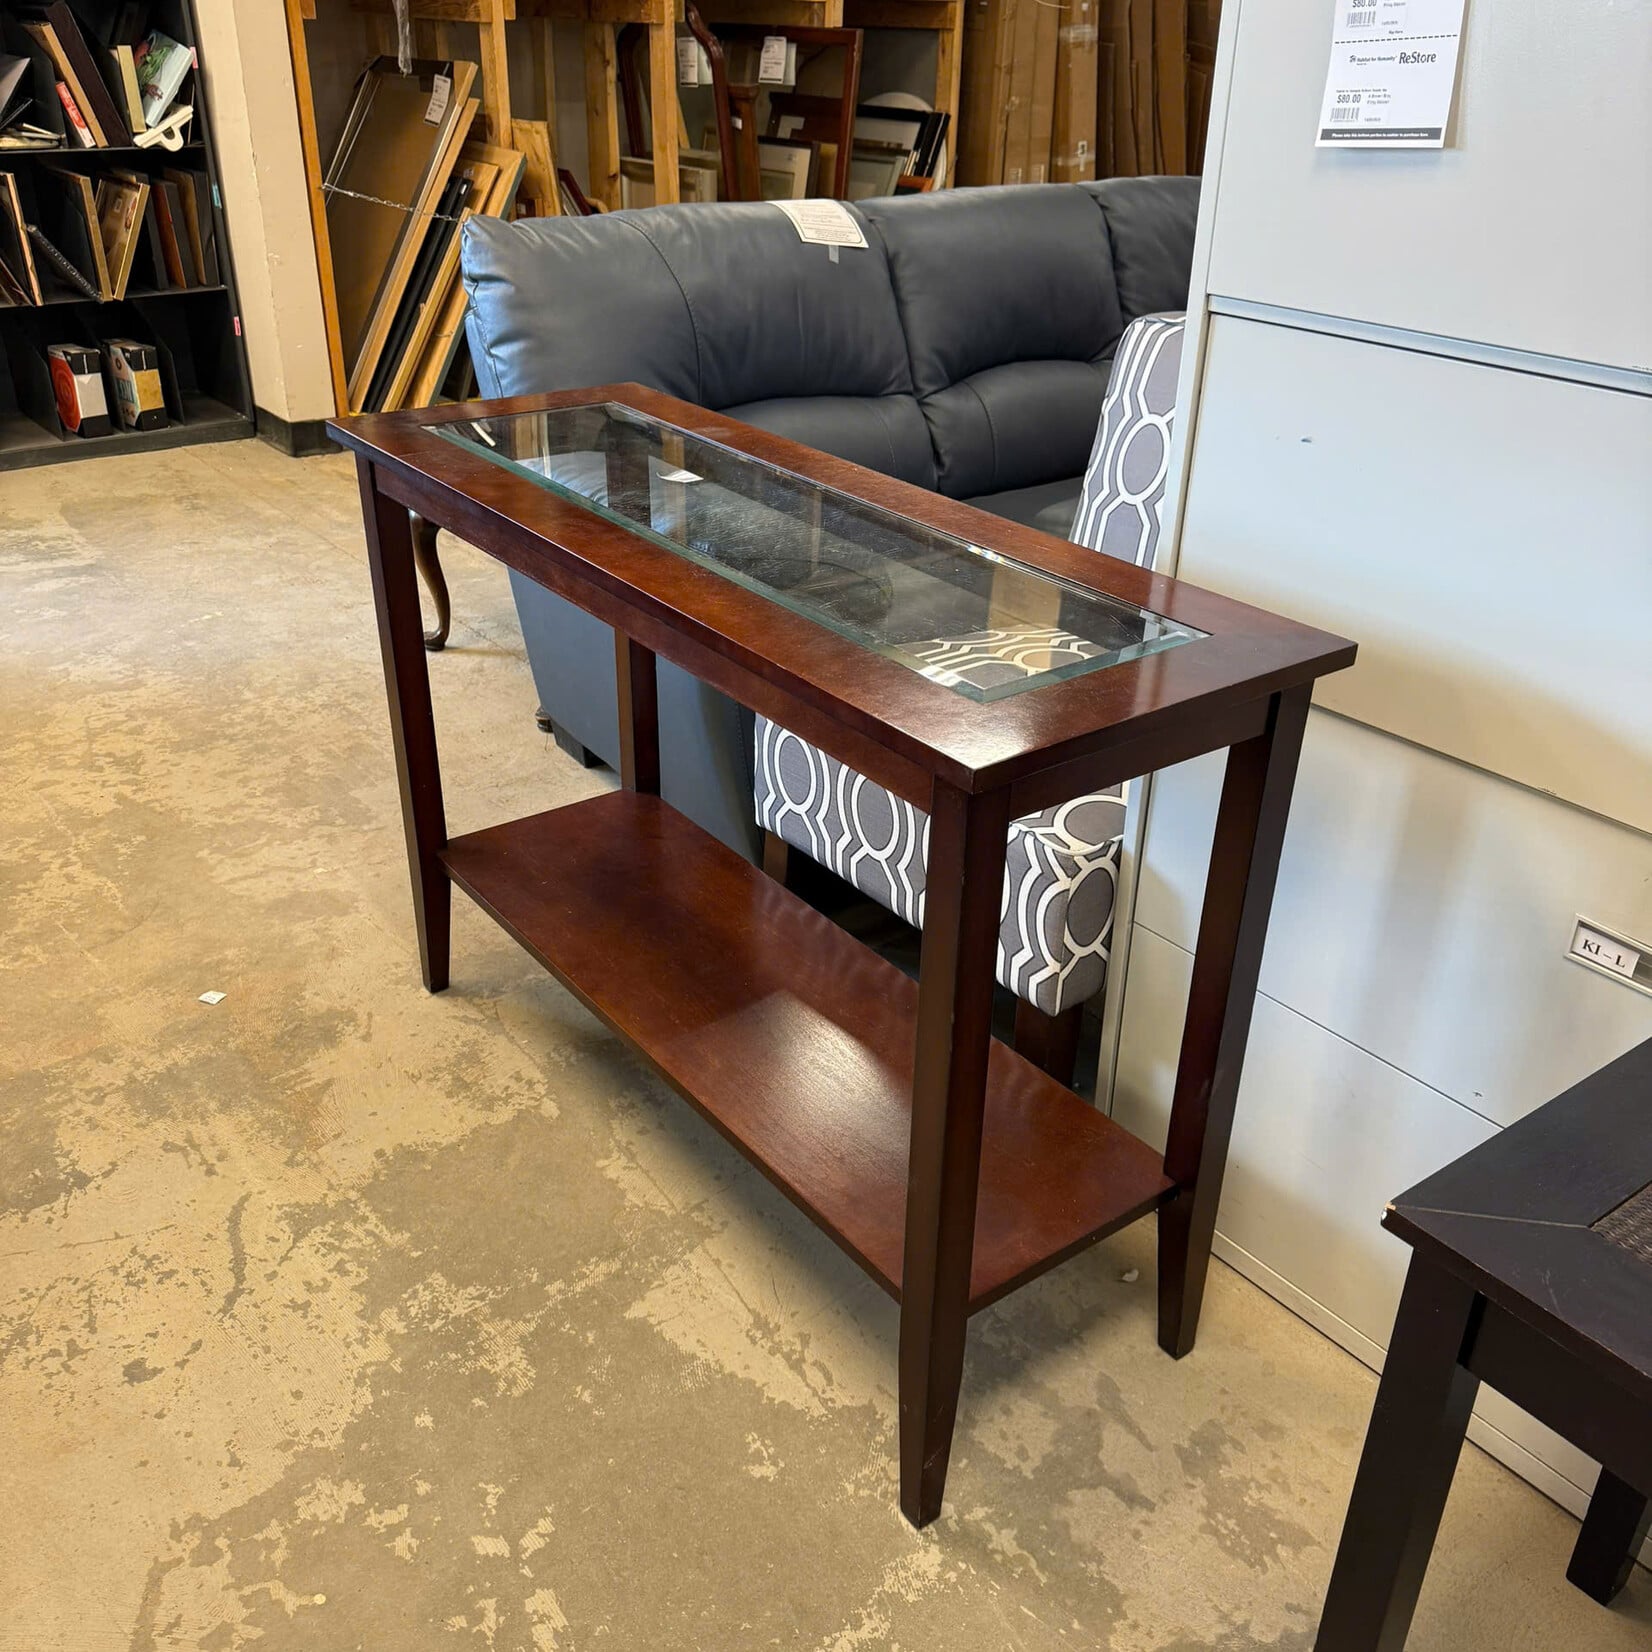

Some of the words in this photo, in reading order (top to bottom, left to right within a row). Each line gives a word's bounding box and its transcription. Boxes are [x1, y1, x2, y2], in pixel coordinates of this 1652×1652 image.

[1399, 51, 1436, 64] ReStore
[1337, 94, 1361, 104] $80.00
[1583, 939, 1601, 955] KI
[1615, 955, 1625, 968] L
